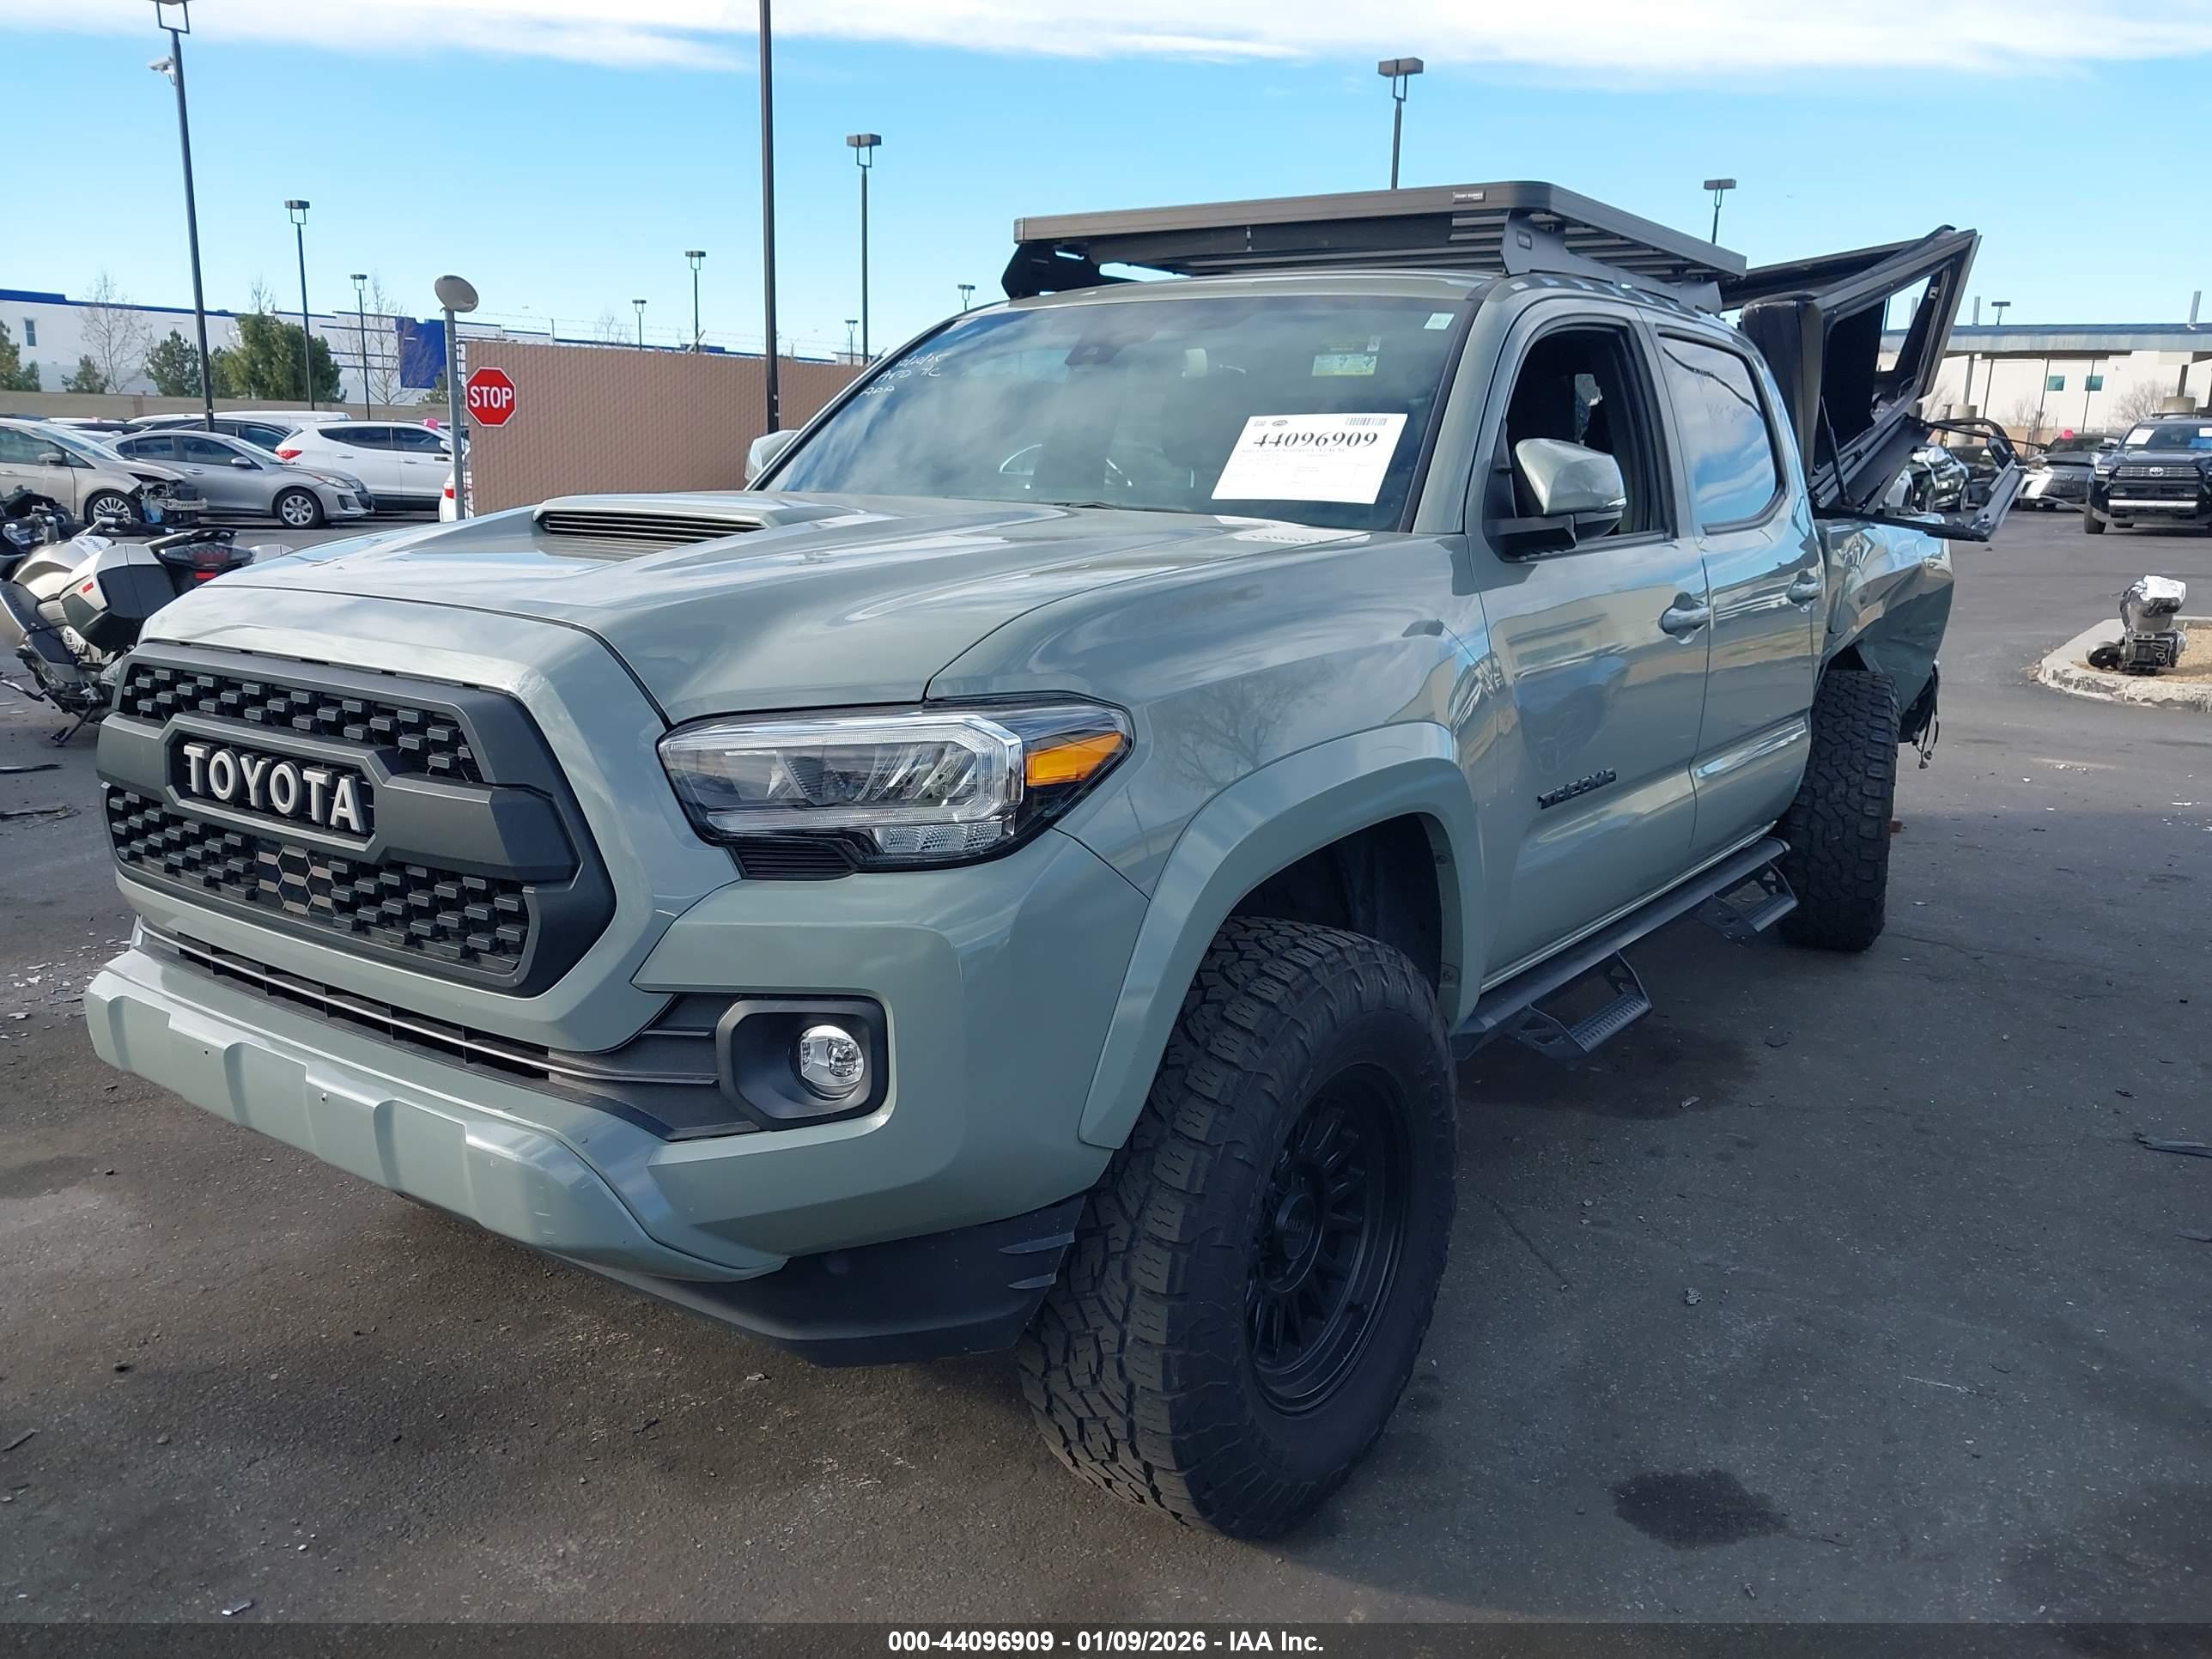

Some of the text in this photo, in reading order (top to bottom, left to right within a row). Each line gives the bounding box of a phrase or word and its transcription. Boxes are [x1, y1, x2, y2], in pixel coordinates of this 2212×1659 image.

[470, 386, 513, 409] STOP
[1253, 432, 1378, 447] 44096909
[183, 744, 367, 832] TOYOTA
